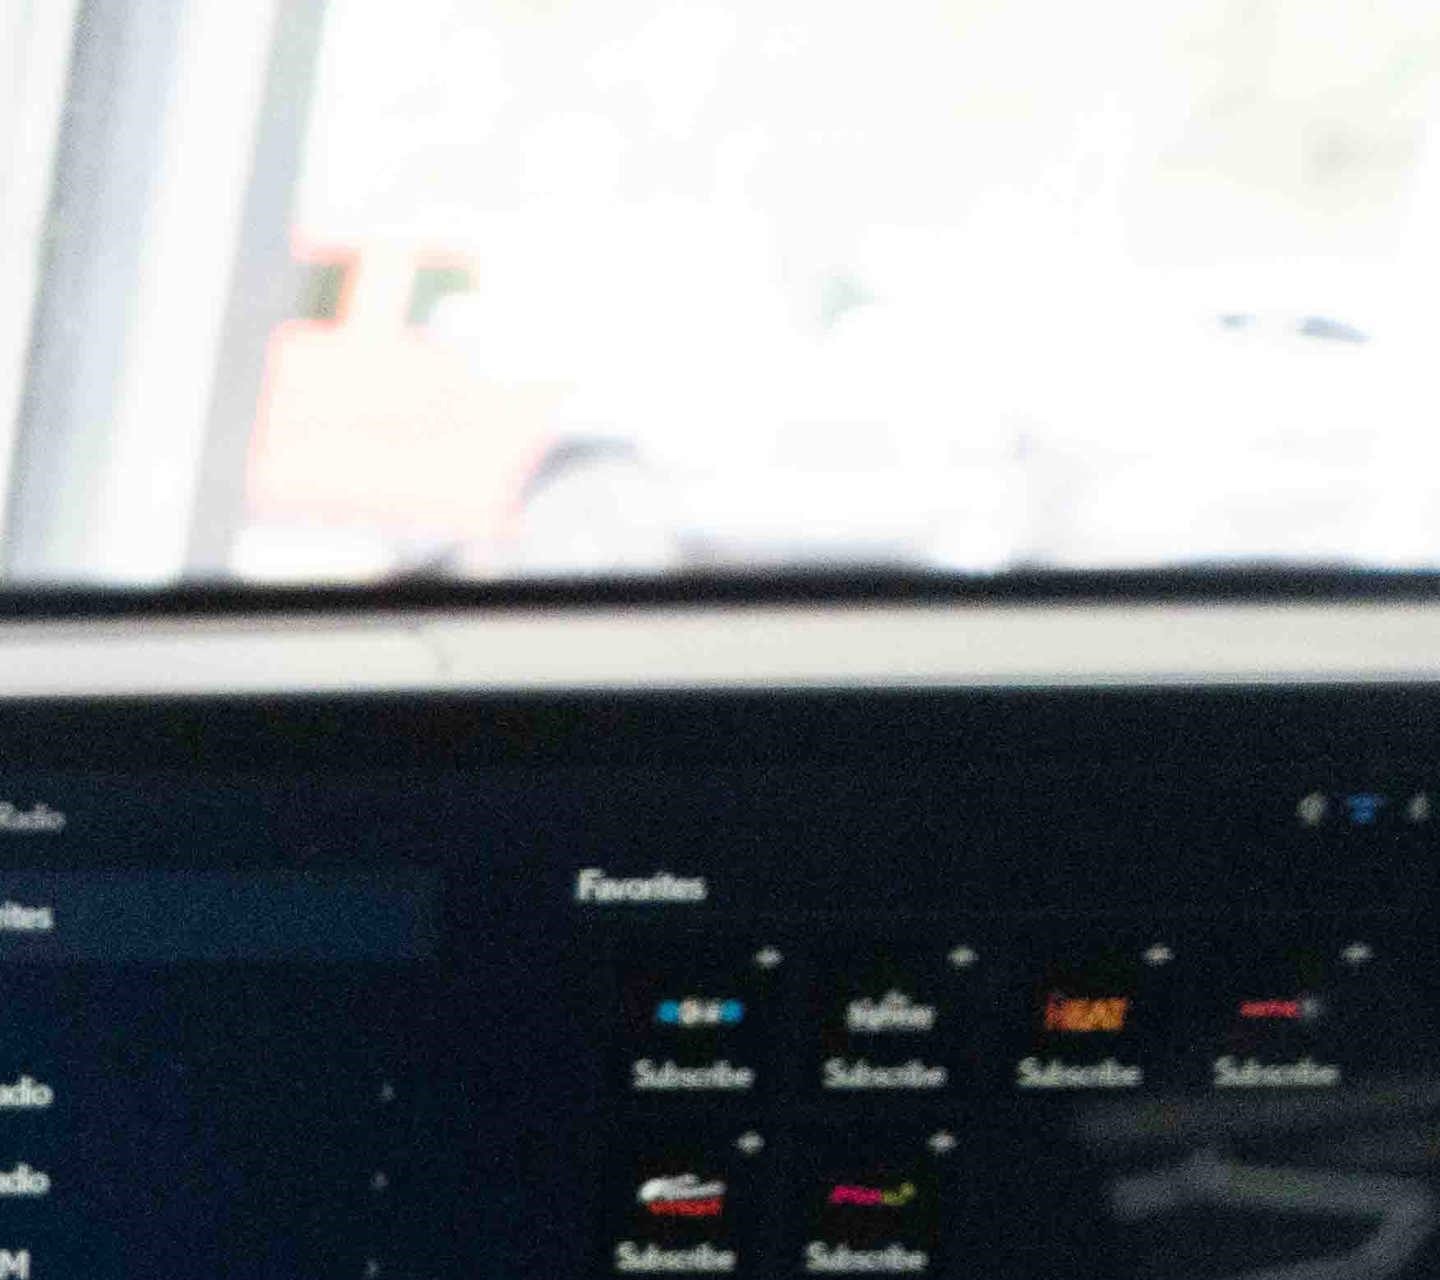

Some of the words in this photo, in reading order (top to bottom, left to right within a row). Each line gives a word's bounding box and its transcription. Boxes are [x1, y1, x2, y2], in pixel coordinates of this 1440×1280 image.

[575, 869, 707, 903] Favorites
[632, 1058, 756, 1089] Subscribe
[823, 1057, 947, 1088] Subscribe
[1017, 1056, 1144, 1087] Subscribe
[1214, 1055, 1341, 1086] Subscribe
[615, 1242, 737, 1273] Subscribe
[805, 1241, 929, 1272] Subscribe
